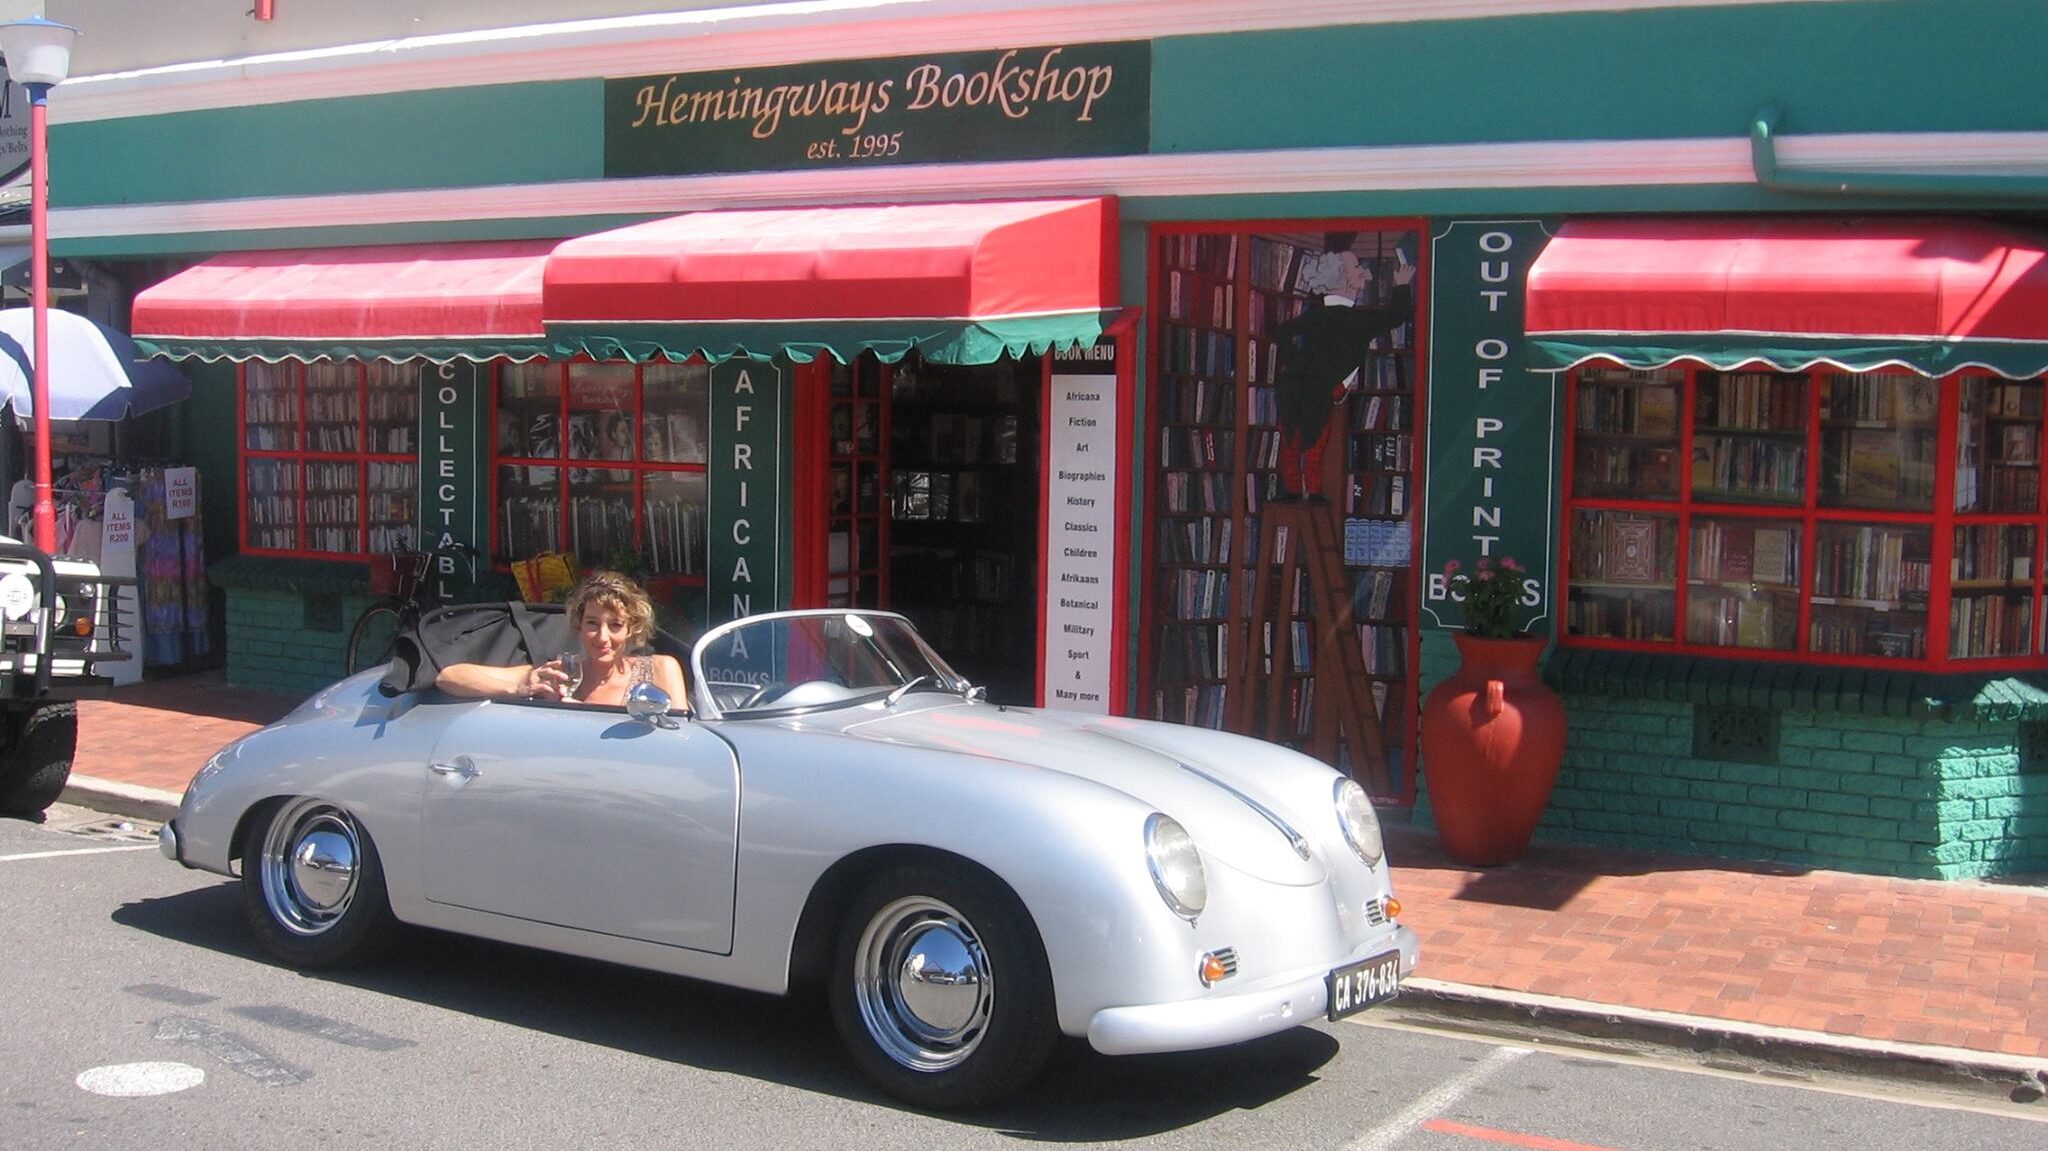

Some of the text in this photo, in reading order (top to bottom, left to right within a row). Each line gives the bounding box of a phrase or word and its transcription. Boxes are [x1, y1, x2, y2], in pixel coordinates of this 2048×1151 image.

[632, 48, 1113, 139] Hemingways Bookshop
[807, 131, 904, 159] est. 1995
[1066, 392, 1100, 402] Africana
[1472, 232, 1513, 556] OUT OF PRINT
[1069, 417, 1097, 427] Fiction
[1076, 443, 1089, 452] Art
[1058, 470, 1106, 481] Biographies
[172, 478, 188, 487] ALL
[169, 488, 193, 498] ITEMS
[1066, 496, 1095, 508] History
[112, 512, 127, 520] ALL
[730, 369, 754, 660] AFRICANA
[107, 522, 132, 532] ITEMS
[1064, 522, 1098, 532] Classics
[109, 533, 129, 543] R200
[1064, 547, 1097, 558] Children
[1061, 573, 1099, 584] Afrikaans
[1060, 598, 1098, 610] Botanical
[1063, 624, 1094, 637] Military
[1068, 650, 1089, 660] Sport
[1075, 671, 1081, 680] &
[1056, 689, 1099, 701] Many more
[1335, 959, 1398, 1012] CA 376-834
